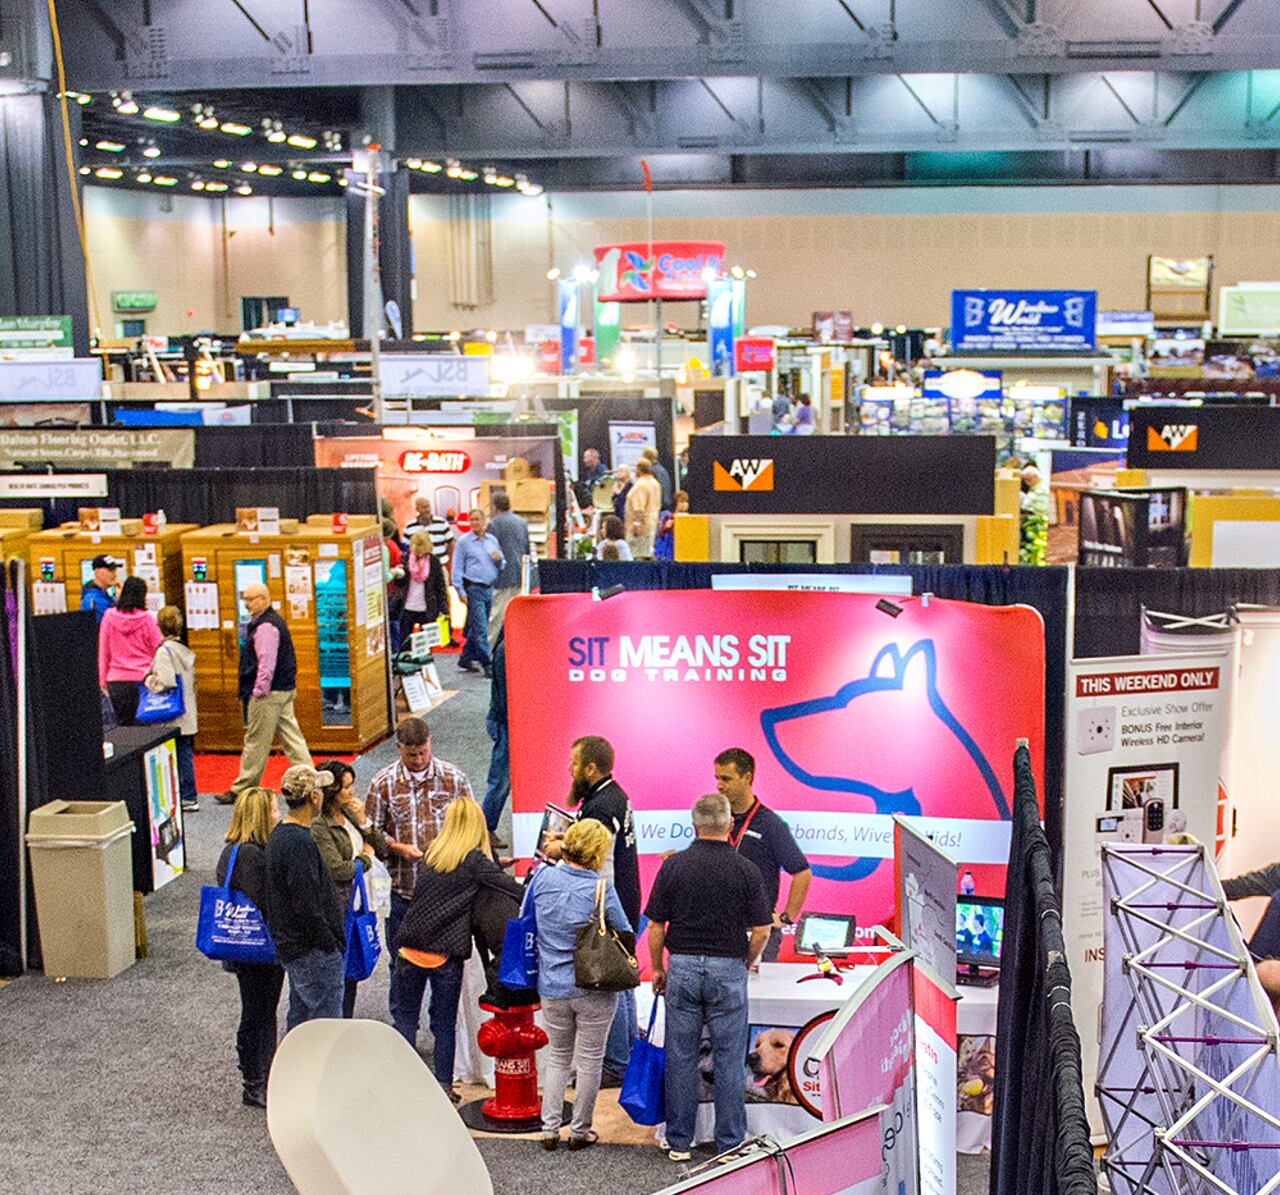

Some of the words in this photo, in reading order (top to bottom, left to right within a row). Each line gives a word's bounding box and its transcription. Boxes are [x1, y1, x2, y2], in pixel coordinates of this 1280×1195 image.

[567, 636, 610, 668] SIT
[619, 634, 740, 668] MEANS
[747, 634, 792, 667] SIT
[568, 668, 627, 682] DOG
[643, 668, 788, 682] TRAINING
[1080, 677, 1111, 694] THIS
[1114, 673, 1177, 691] WEEKEND
[1180, 671, 1214, 688] ONLY
[1122, 704, 1162, 718] Exclusive
[1165, 702, 1189, 715] Show
[1192, 701, 1214, 713] Offer
[1122, 723, 1153, 735] BONUS
[1156, 722, 1172, 732] Free
[1121, 737, 1154, 748] Wireless
[1157, 735, 1170, 745] HD
[641, 823, 666, 841] We
